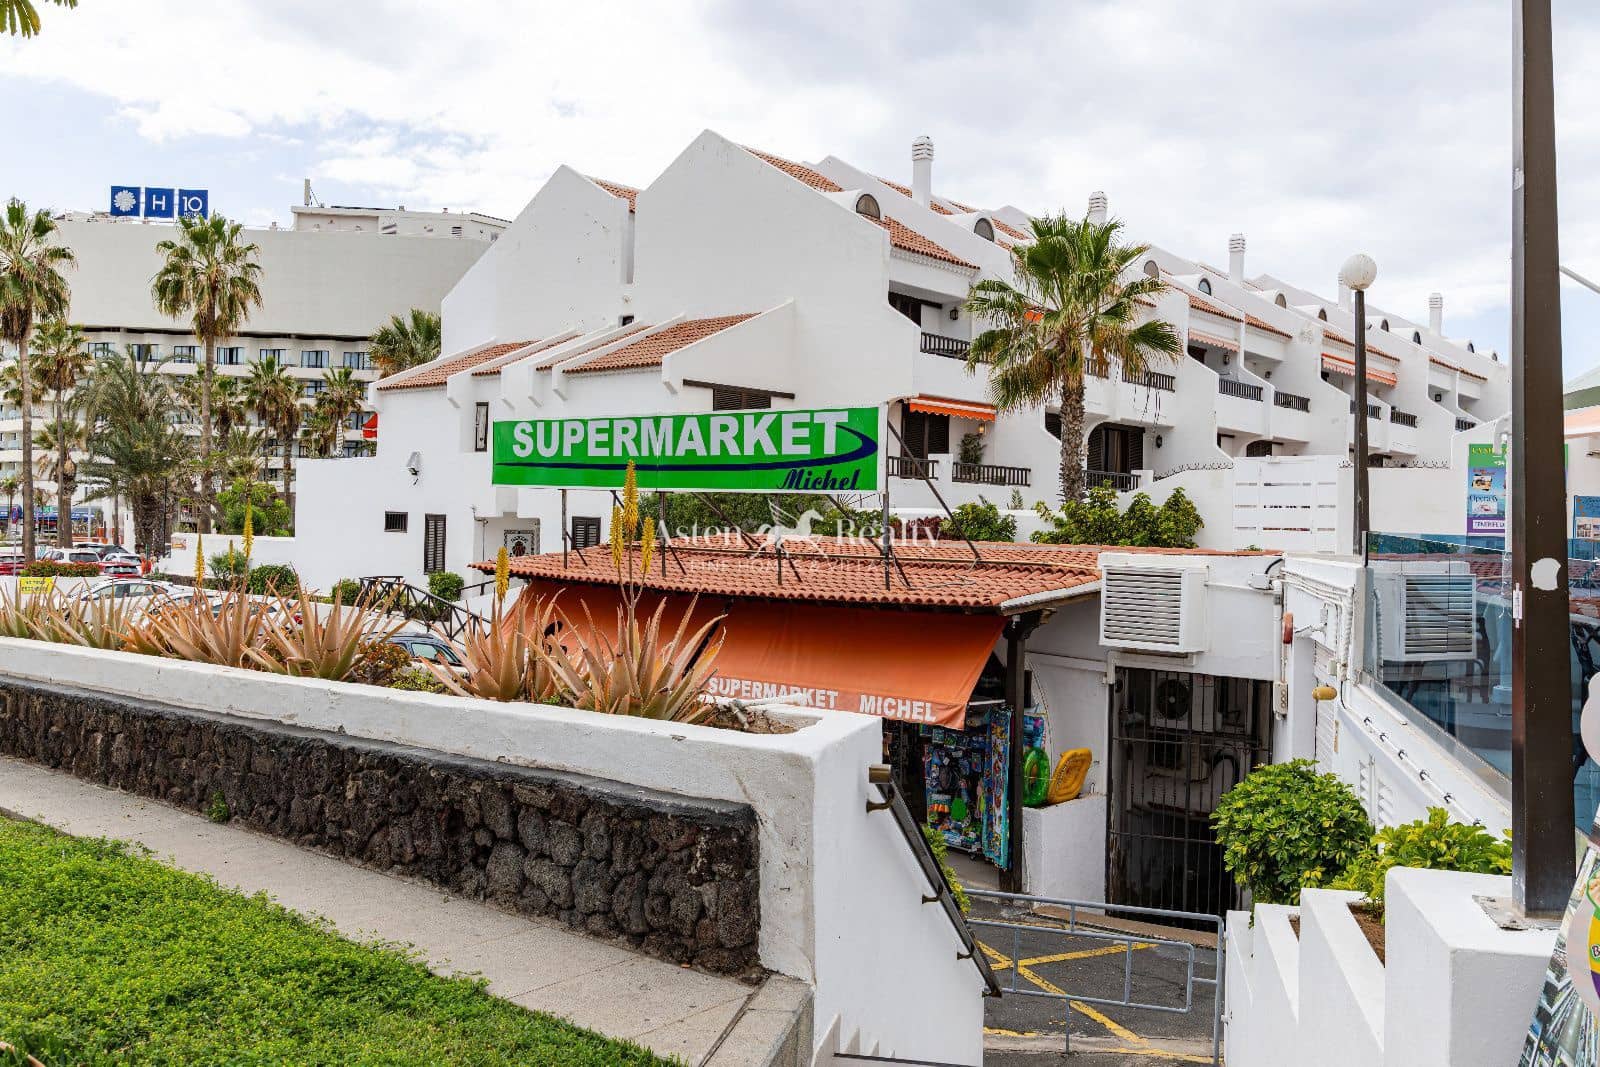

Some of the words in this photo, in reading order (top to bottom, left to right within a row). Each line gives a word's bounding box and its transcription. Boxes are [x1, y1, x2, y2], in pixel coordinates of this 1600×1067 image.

[152, 194, 166, 211] H
[182, 196, 203, 212] 10
[512, 411, 849, 459] SUPERMARKET
[776, 469, 861, 491] Michel
[859, 694, 937, 722] MICHEL
